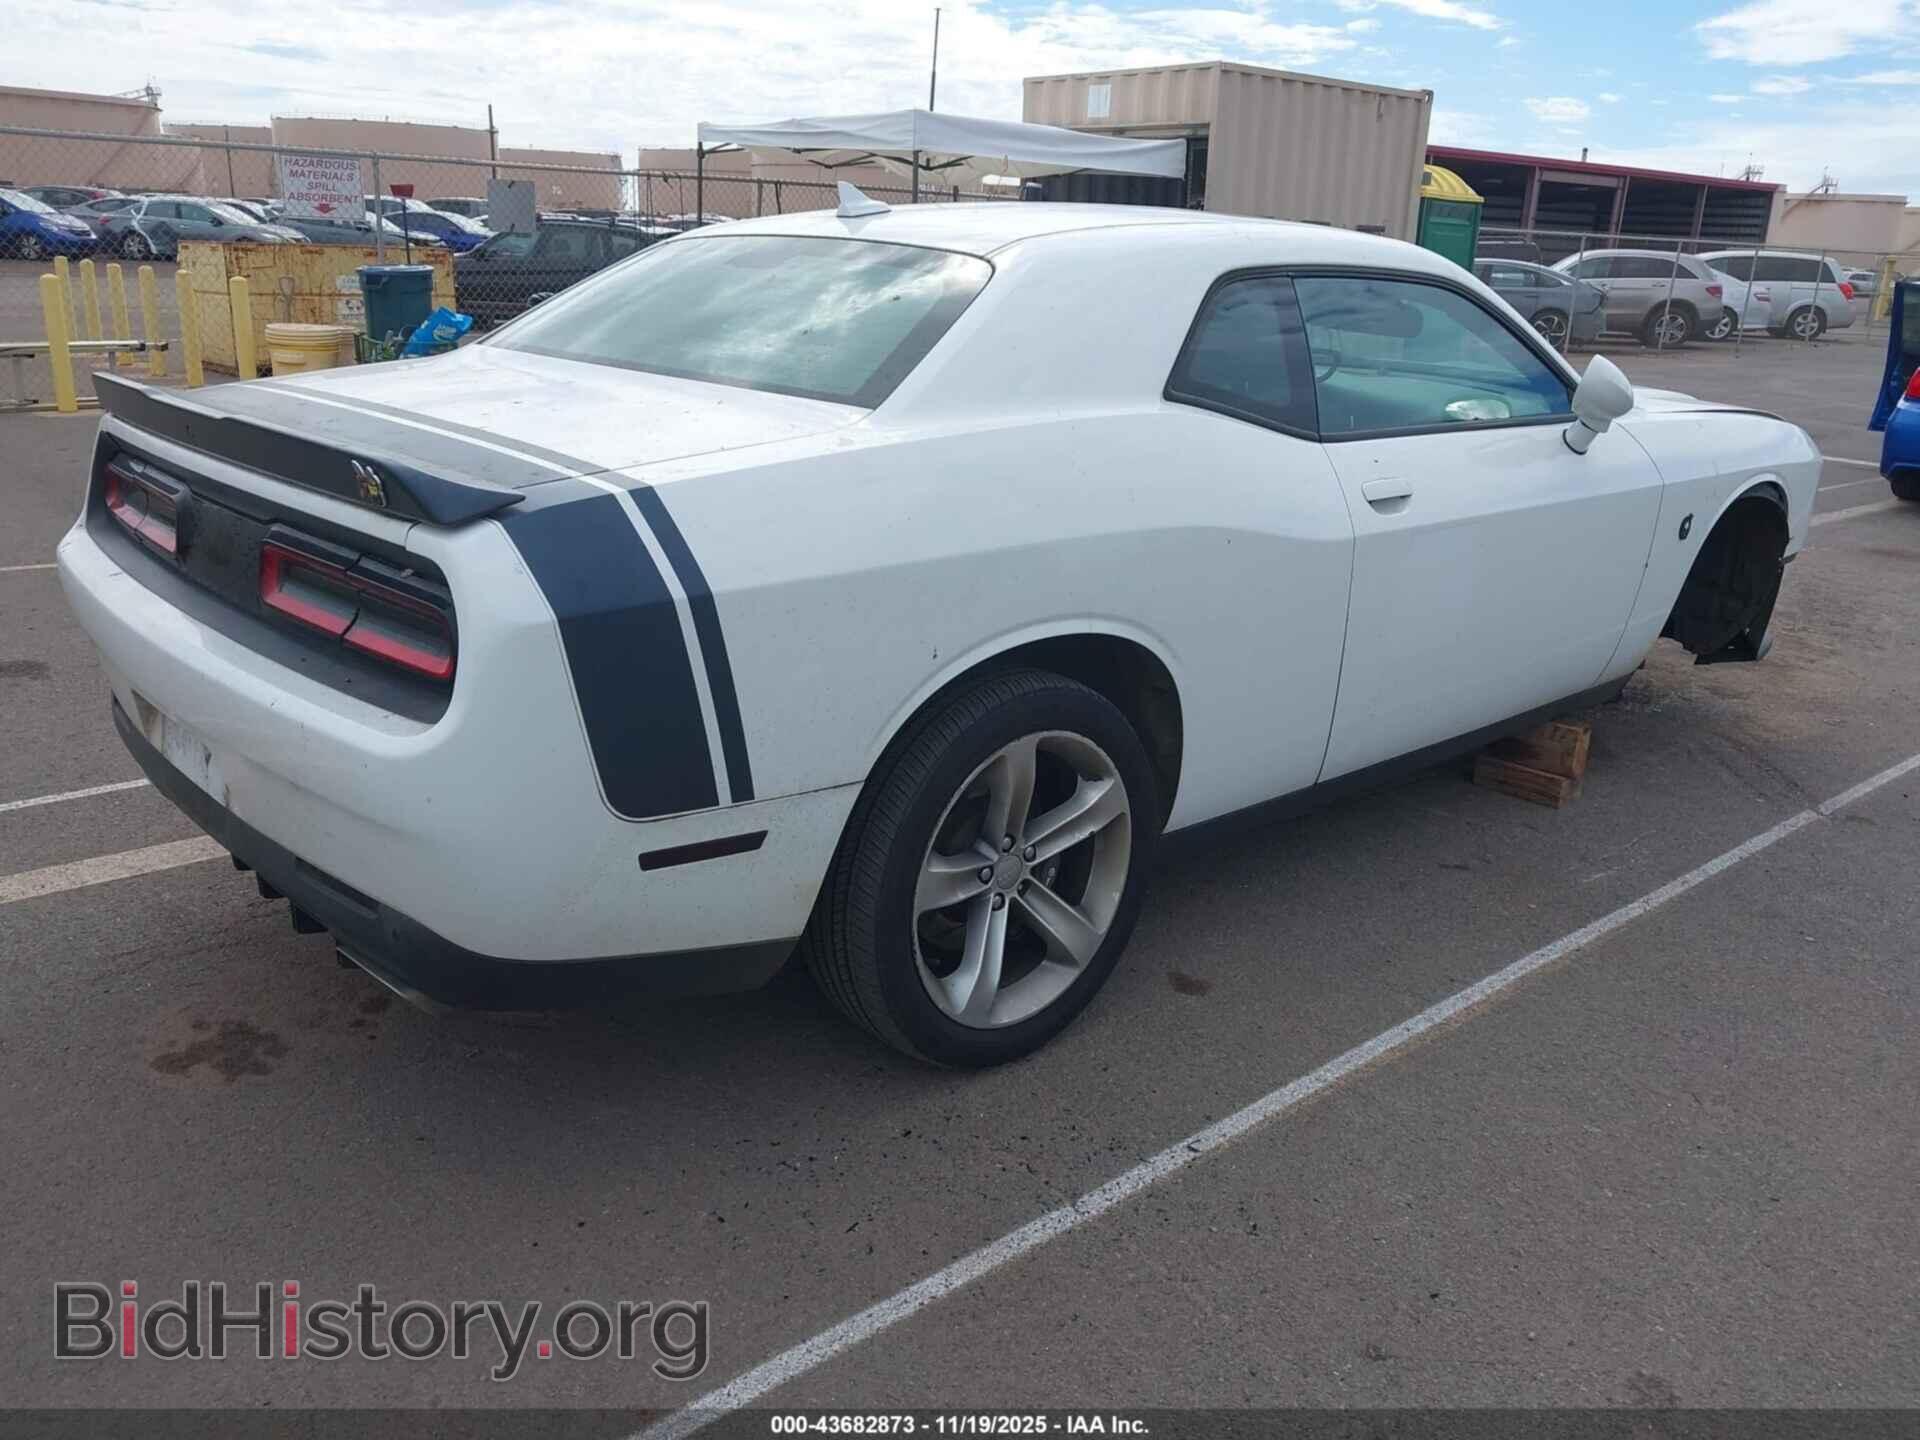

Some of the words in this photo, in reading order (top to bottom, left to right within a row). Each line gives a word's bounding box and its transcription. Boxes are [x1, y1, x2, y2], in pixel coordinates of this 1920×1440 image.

[284, 157, 357, 171] HAZARDOUS
[288, 169, 355, 182] MATERIALS
[306, 181, 337, 192] SPILL
[288, 191, 359, 204] ABSORBENT
